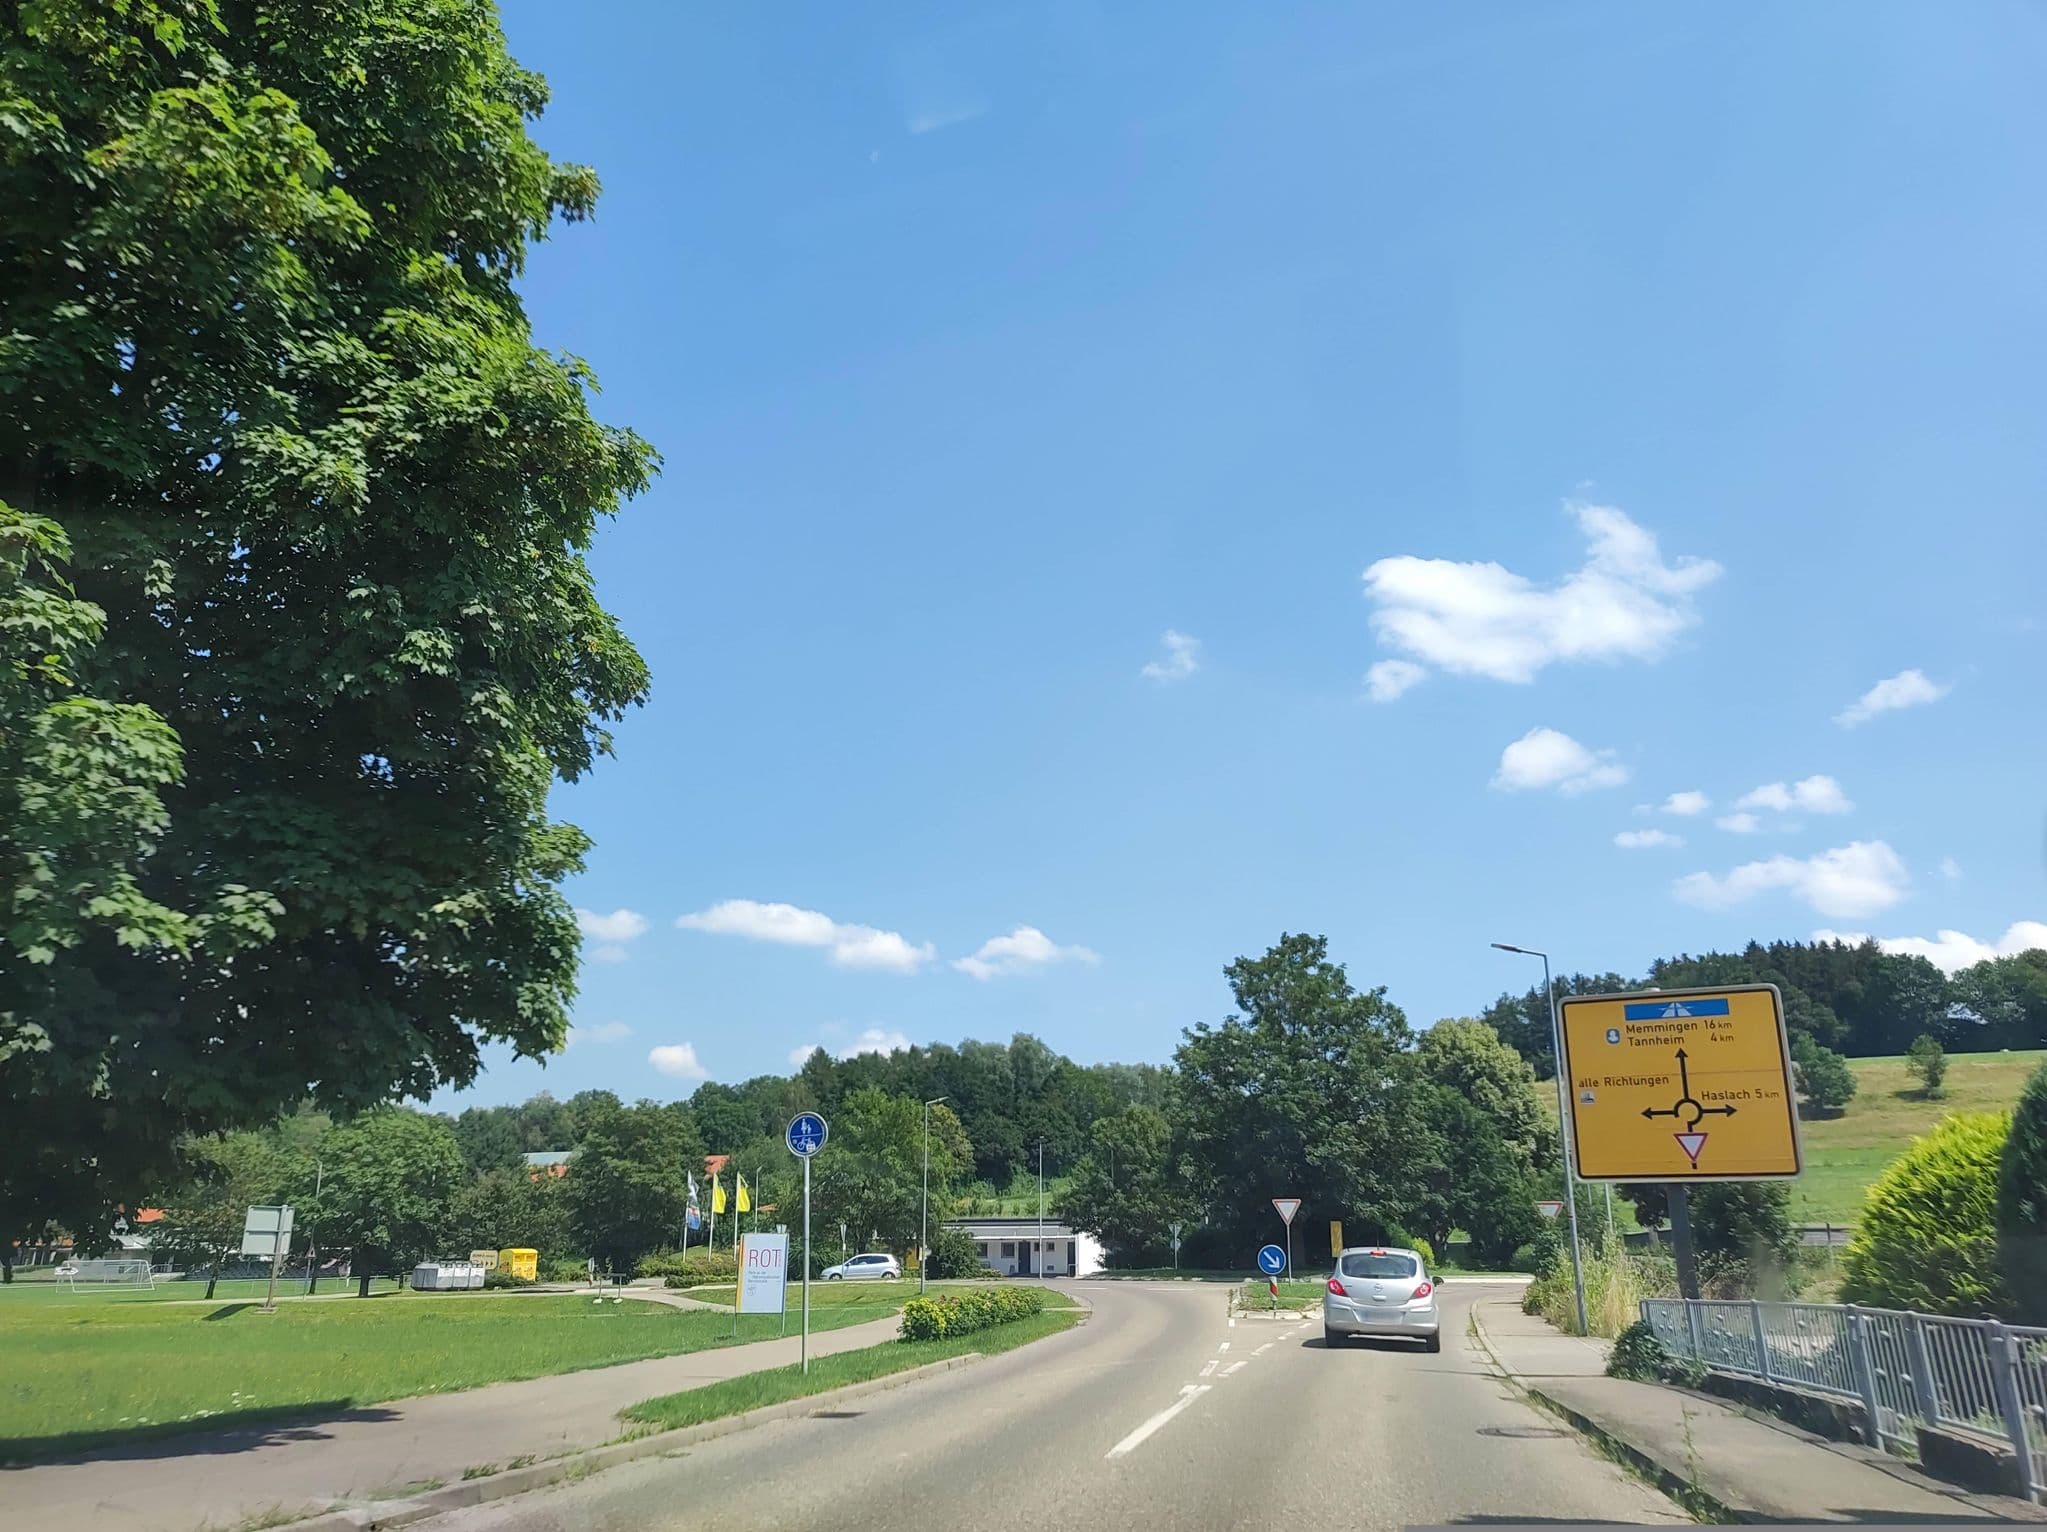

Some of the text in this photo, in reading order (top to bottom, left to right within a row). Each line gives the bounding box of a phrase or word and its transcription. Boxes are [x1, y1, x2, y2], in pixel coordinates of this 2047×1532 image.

[1626, 1020, 1732, 1033] Memmingen 16 km
[1628, 1033, 1734, 1046] Tannheim 4 km
[1579, 1076, 1669, 1088] alle Richtungen
[1701, 1089, 1779, 1101] Haslach 5 km
[749, 1249, 782, 1268] ROT
